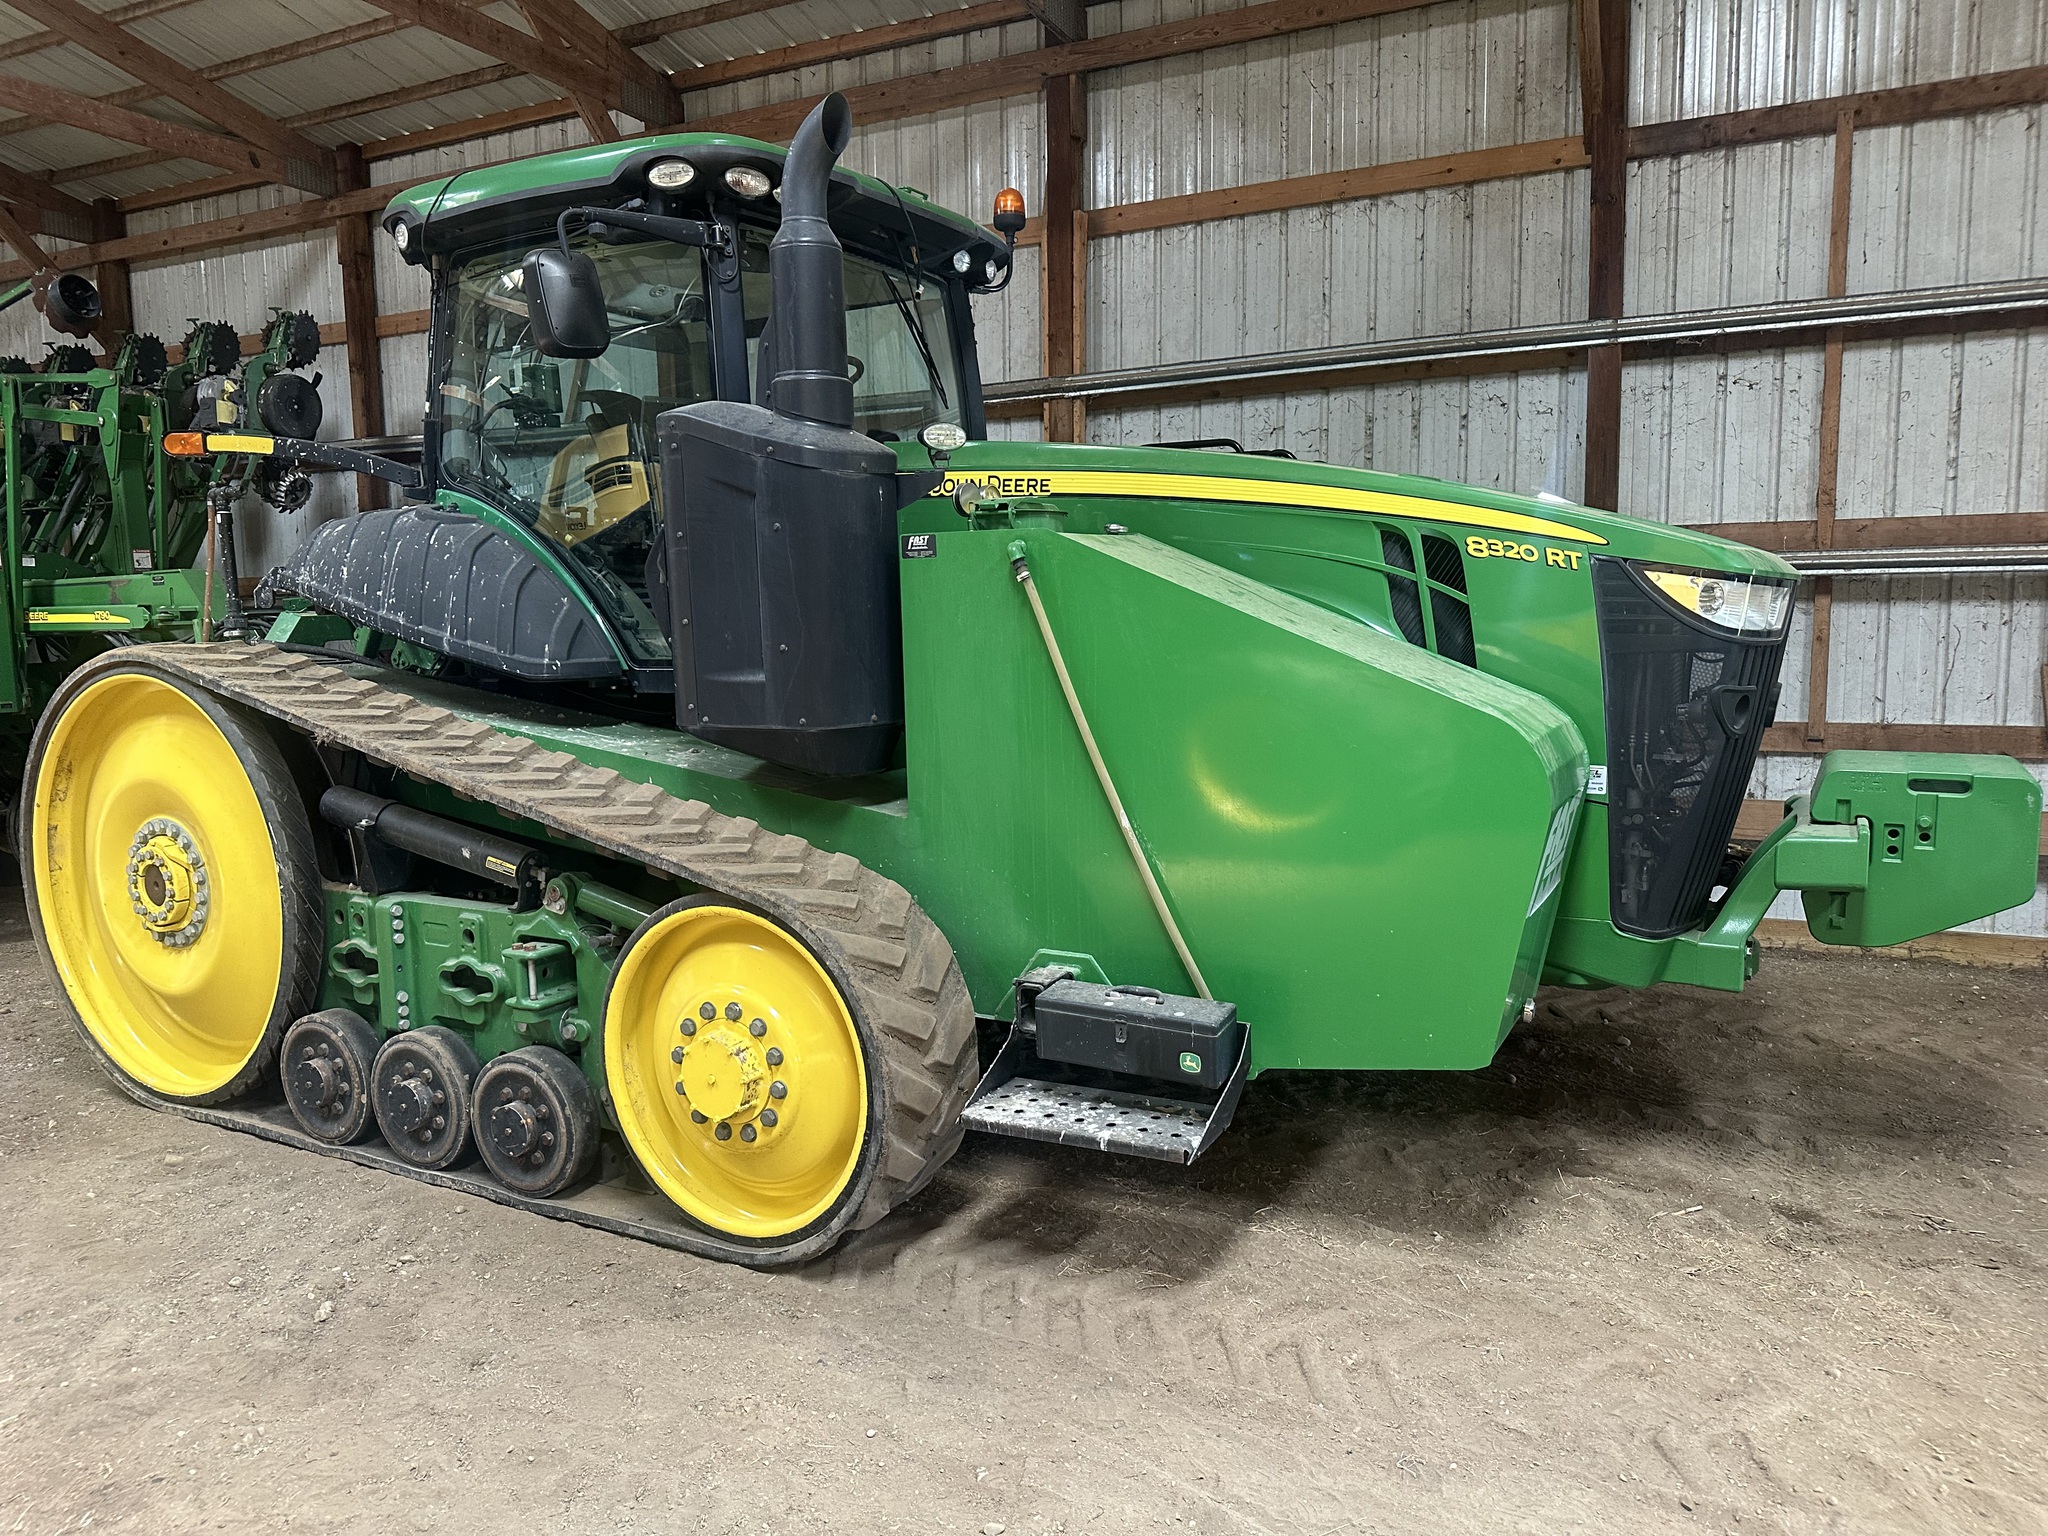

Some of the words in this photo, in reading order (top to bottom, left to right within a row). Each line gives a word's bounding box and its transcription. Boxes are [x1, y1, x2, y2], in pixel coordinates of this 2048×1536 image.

[933, 478, 982, 493] JON
[987, 475, 1051, 493] DEERE
[907, 535, 930, 550] FAST
[1465, 536, 1539, 562] 8320
[1544, 547, 1582, 570] RT
[24, 611, 49, 621] DEERE
[94, 611, 111, 621] 1790
